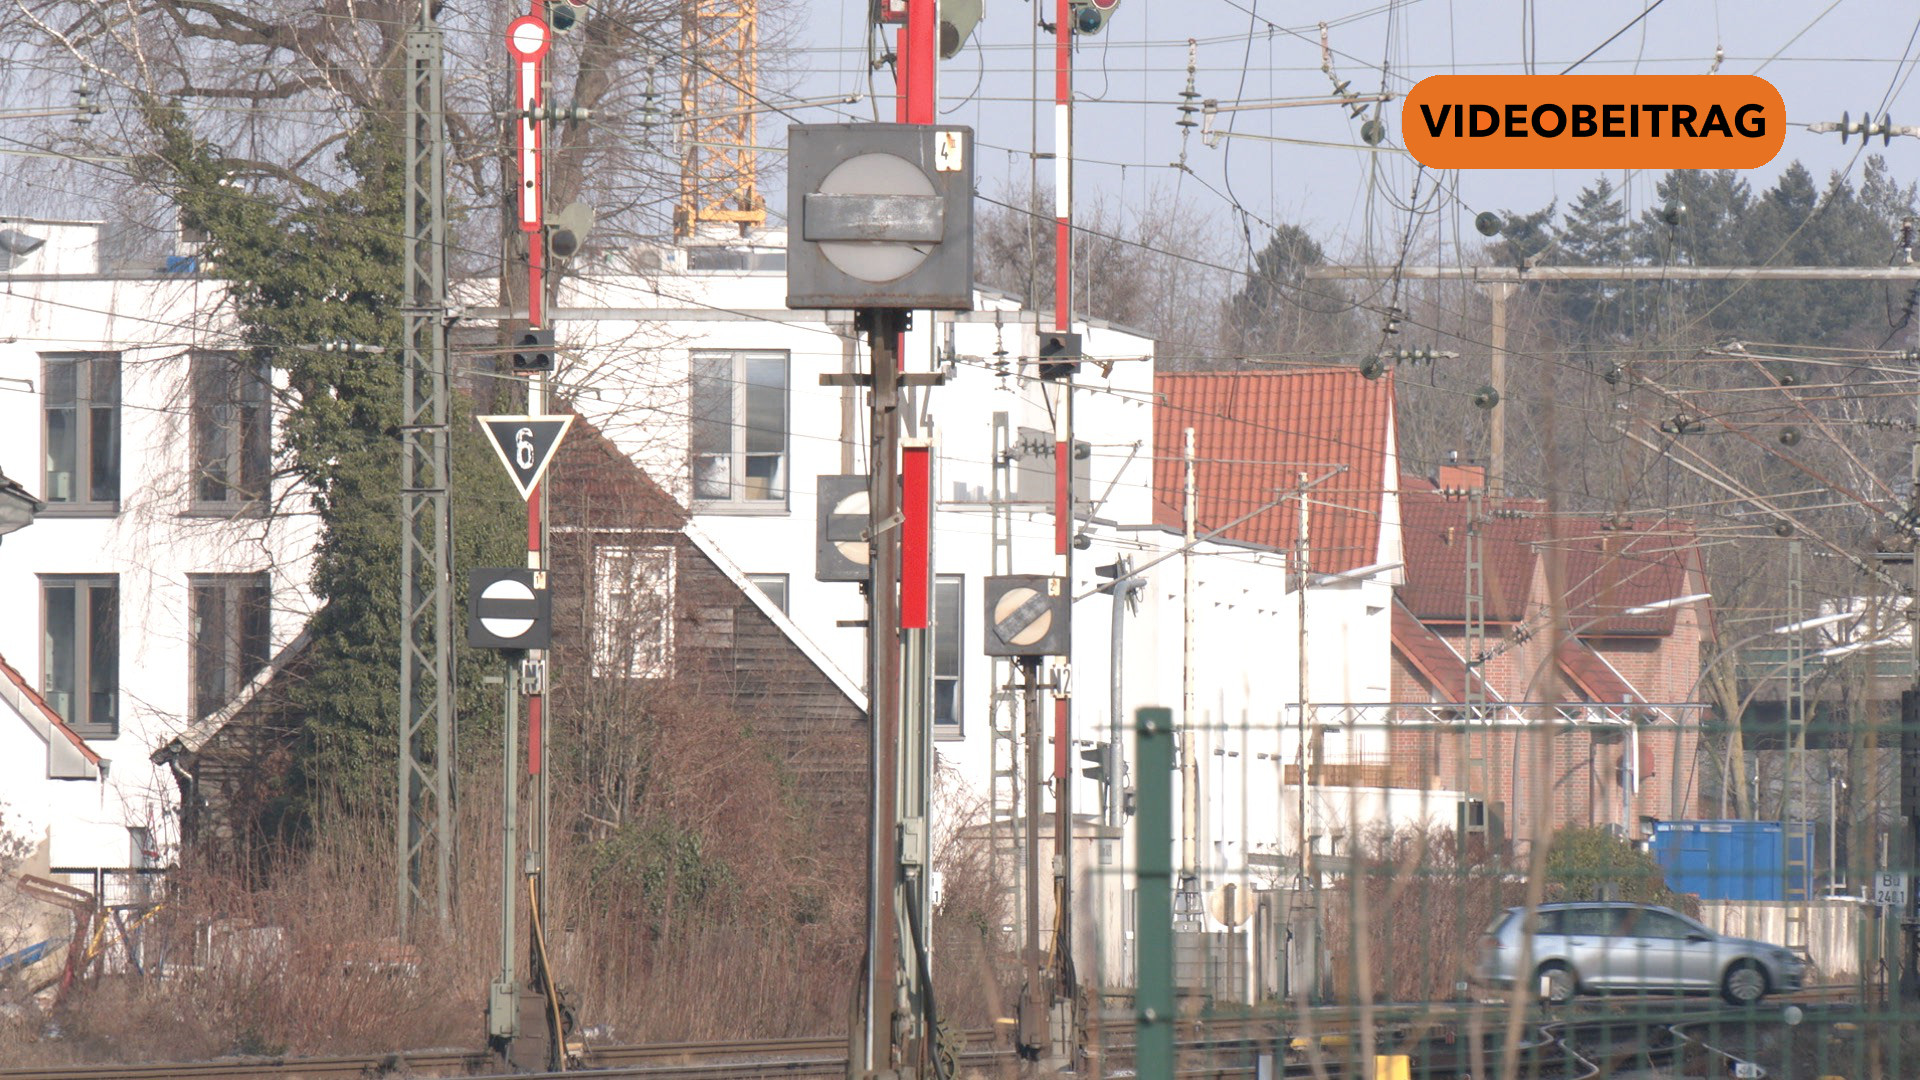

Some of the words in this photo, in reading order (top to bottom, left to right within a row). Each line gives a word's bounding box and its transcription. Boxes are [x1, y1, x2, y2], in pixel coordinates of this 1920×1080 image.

[941, 142, 948, 160] 4
[898, 385, 934, 438] N4
[515, 427, 535, 470] 6
[1049, 668, 1071, 695] N2
